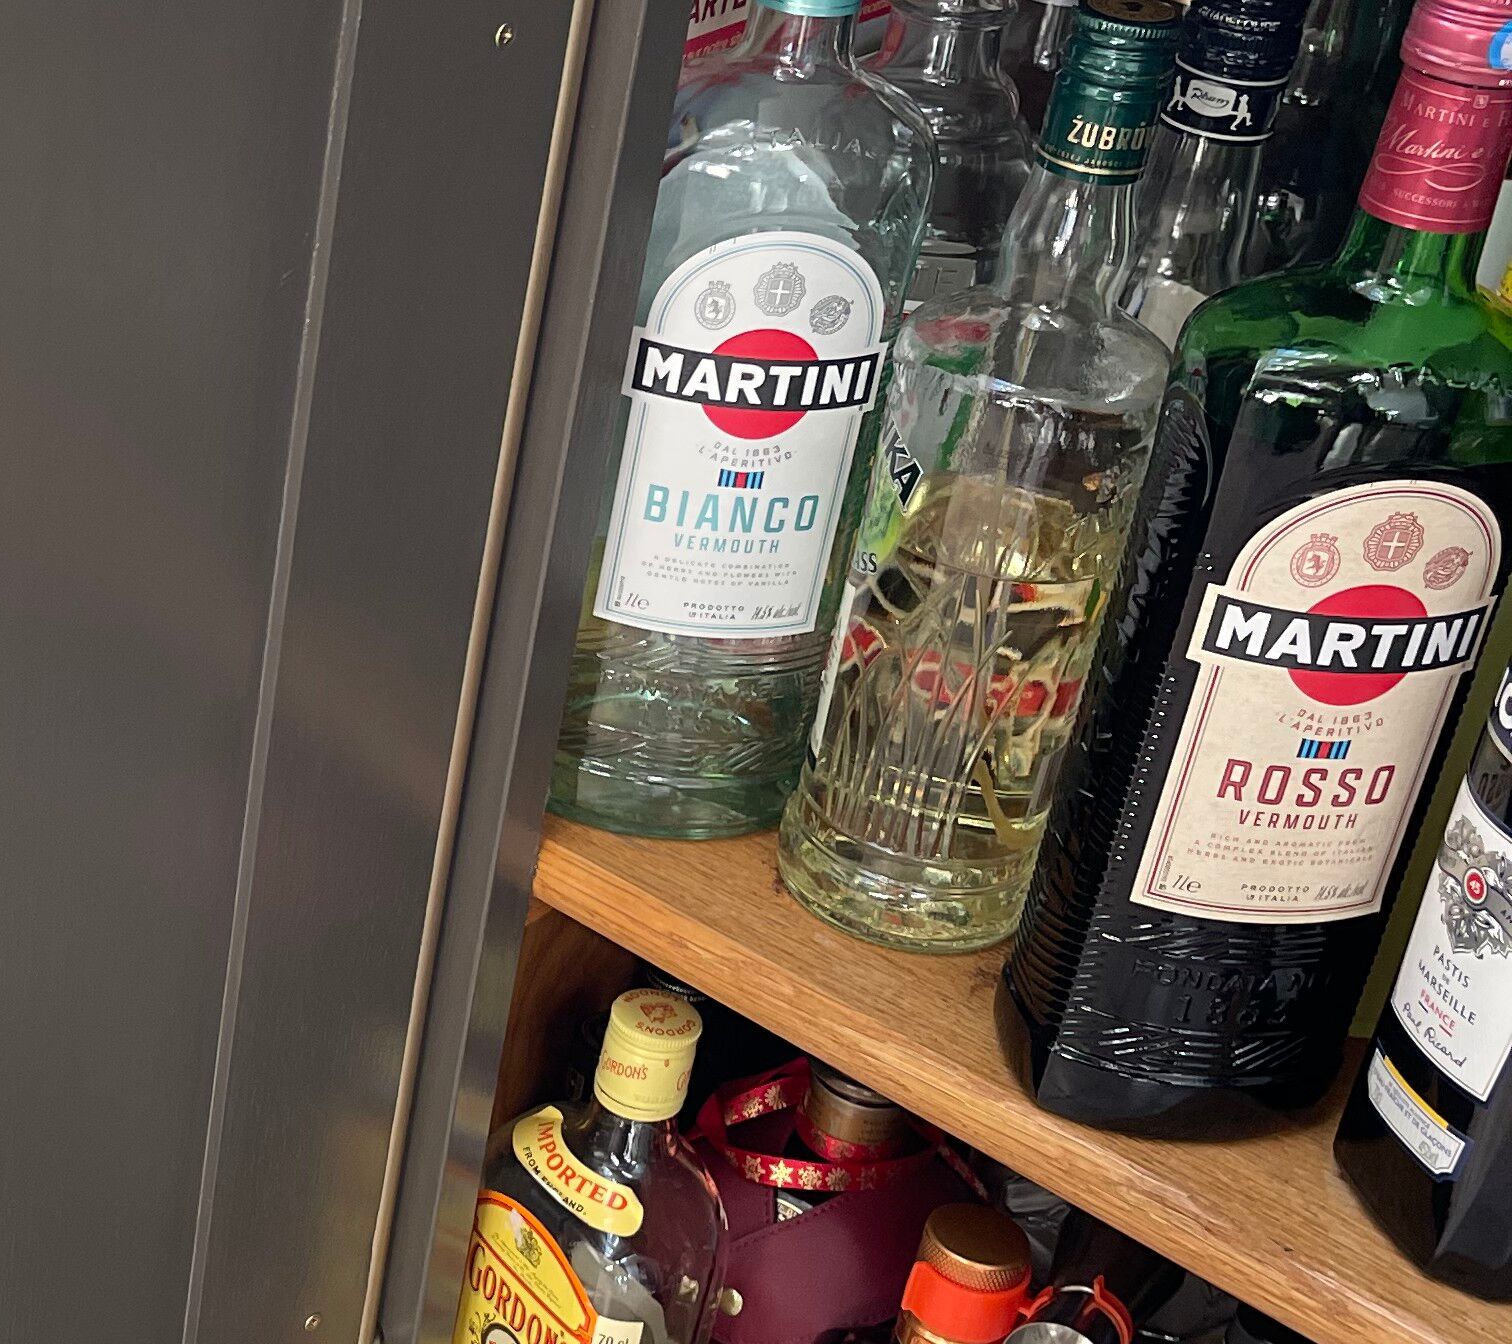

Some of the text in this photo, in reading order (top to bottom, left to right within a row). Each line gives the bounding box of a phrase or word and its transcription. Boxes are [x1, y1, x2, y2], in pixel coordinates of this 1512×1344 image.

[1401, 93, 1476, 129] MARTINI
[641, 346, 872, 406] MARTINI
[643, 483, 820, 534] BIANCO
[674, 533, 780, 554] VERMOUTH
[1215, 603, 1480, 669] MARTINI
[1216, 758, 1396, 807] ROSSO
[1238, 809, 1359, 830] VERMOUTH
[1240, 883, 1310, 894] PRODOTTO
[1433, 945, 1471, 988] PASTIS
[1418, 959, 1477, 1025] MARSEILLE
[1420, 988, 1457, 1031] FRANCE
[1402, 1002, 1468, 1068] Paul Ricard
[522, 1146, 542, 1178] FROM
[537, 1121, 628, 1212] IMPORTED
